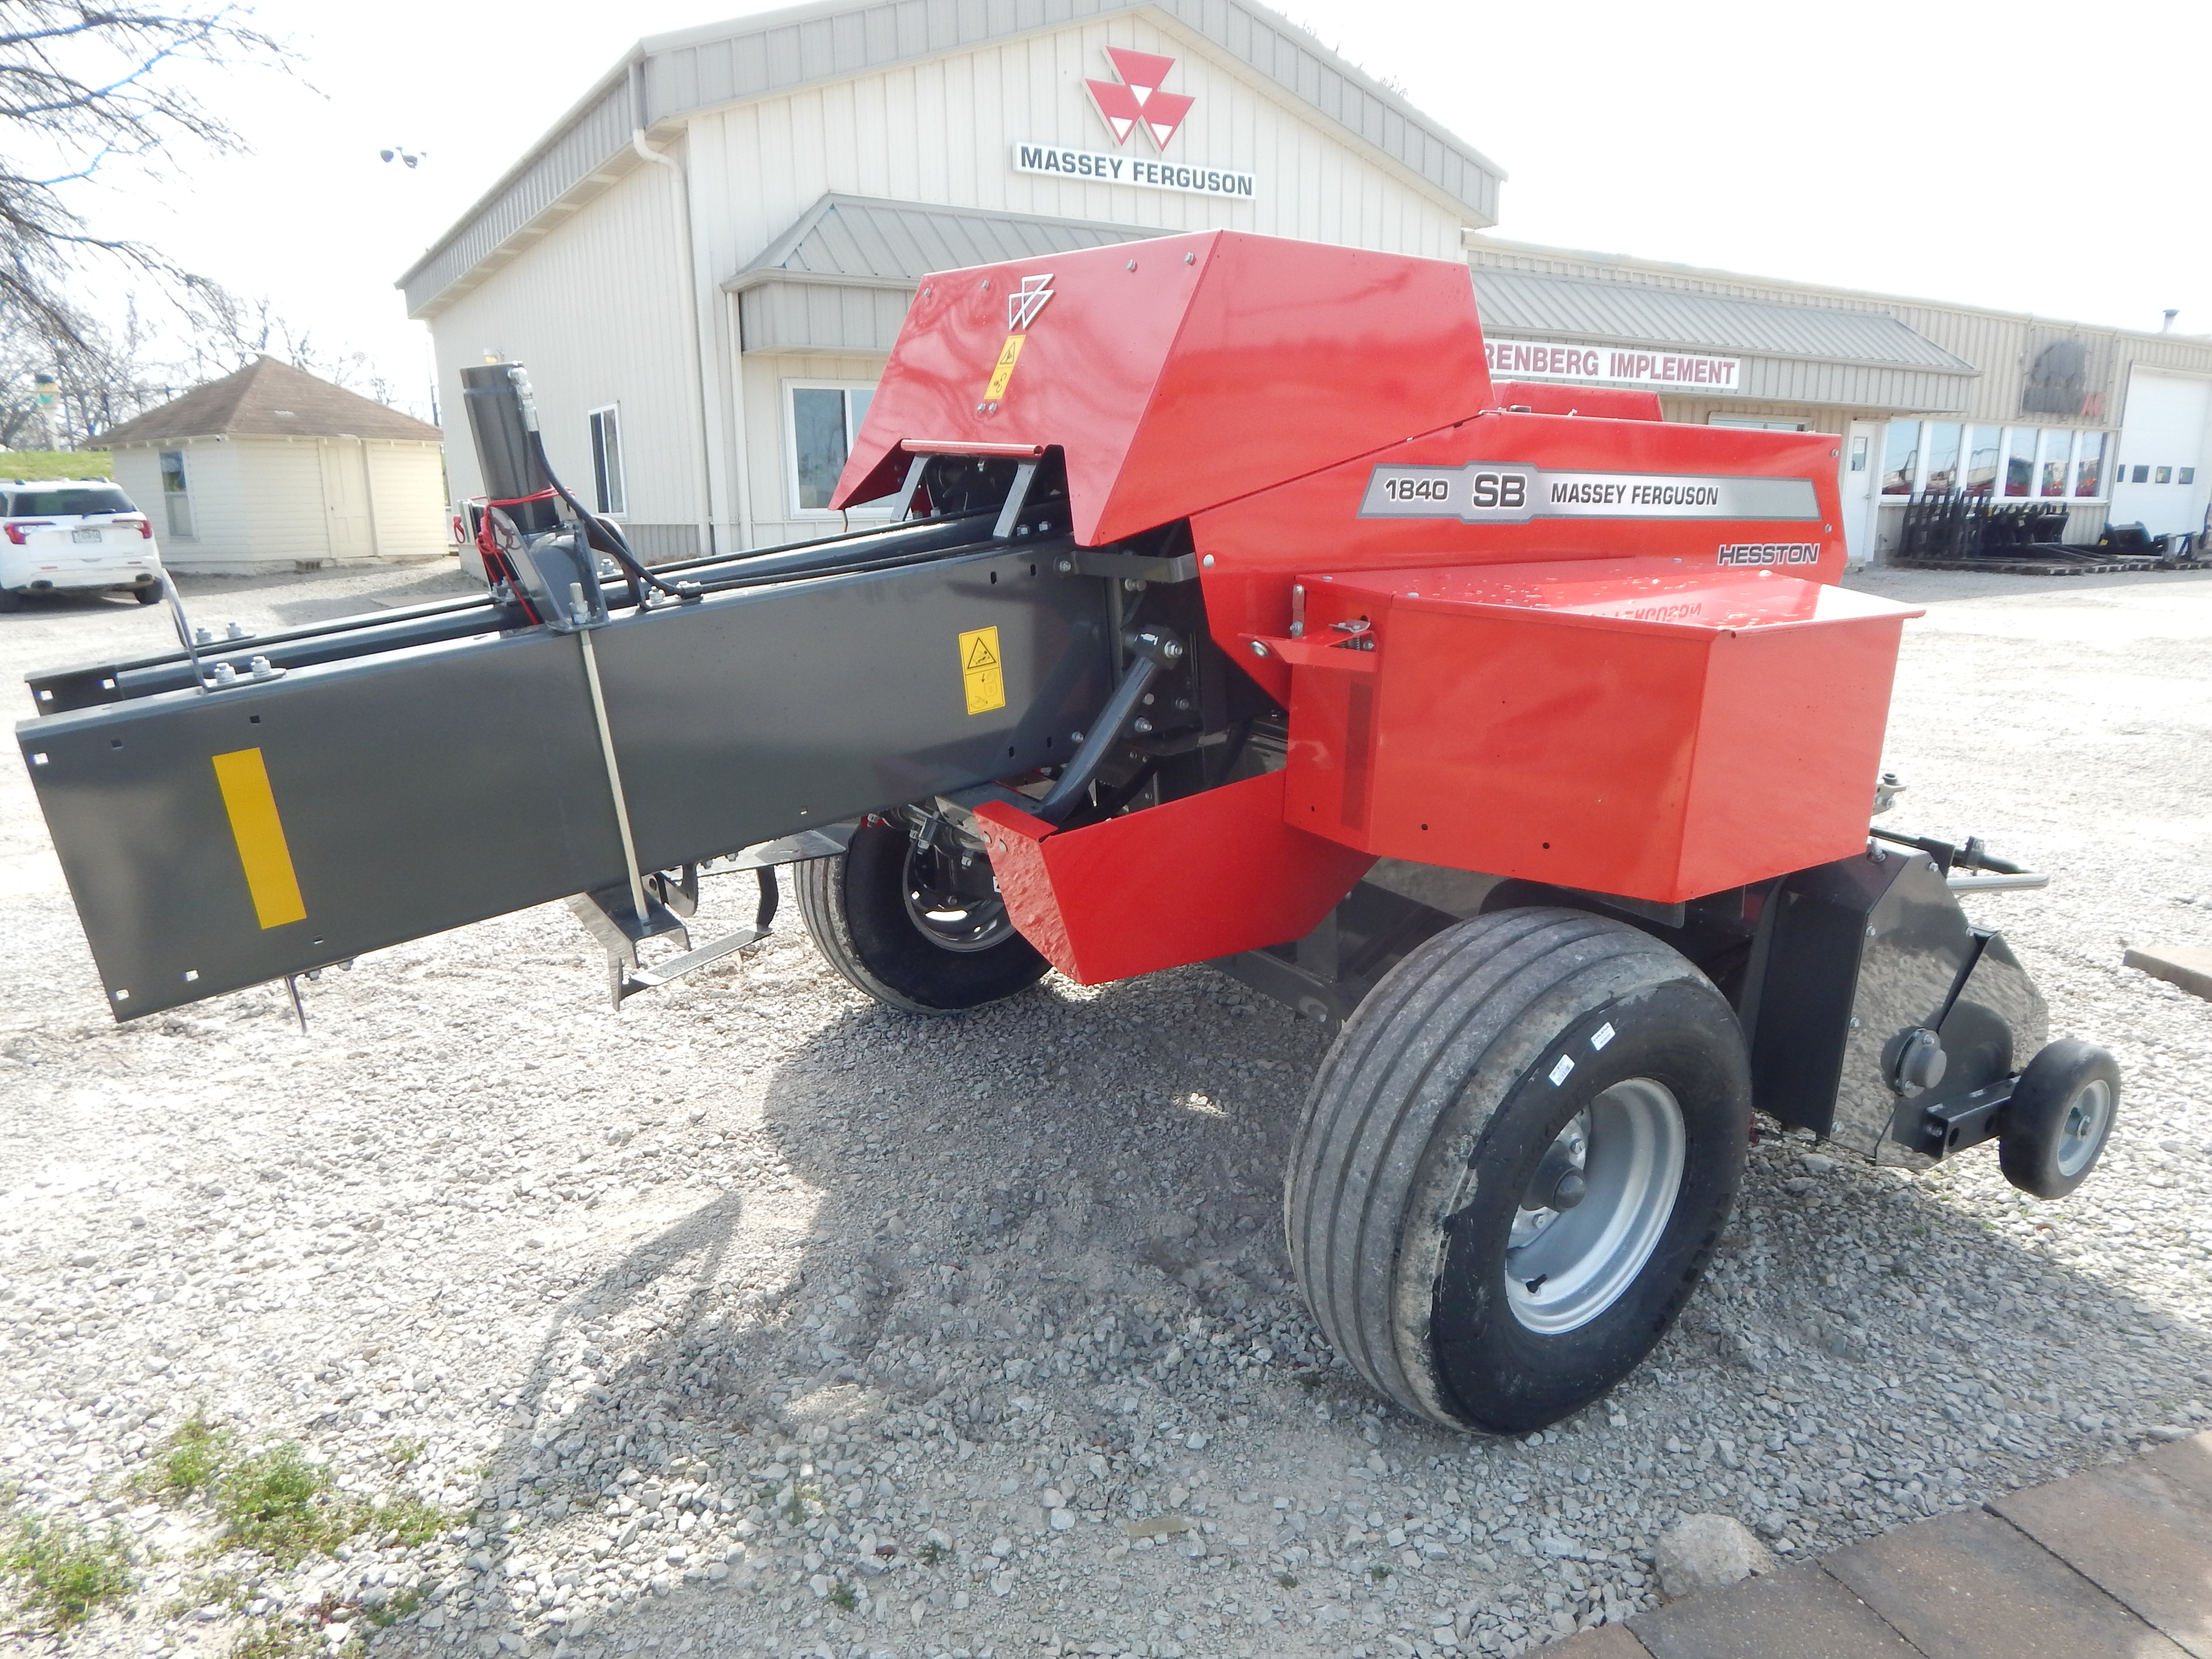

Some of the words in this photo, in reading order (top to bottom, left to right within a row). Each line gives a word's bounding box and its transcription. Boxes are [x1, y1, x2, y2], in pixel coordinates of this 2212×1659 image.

[1021, 146, 1123, 179] MASSEY
[1133, 161, 1253, 196] FERGUSON
[1610, 353, 1735, 384] IMPLEMENT
[1385, 479, 1448, 500] 1840
[1473, 474, 1526, 507] SB
[1551, 482, 1626, 504] MASSEY
[1632, 485, 1719, 505] FERGUSON
[1718, 543, 1821, 566] HESSTON
